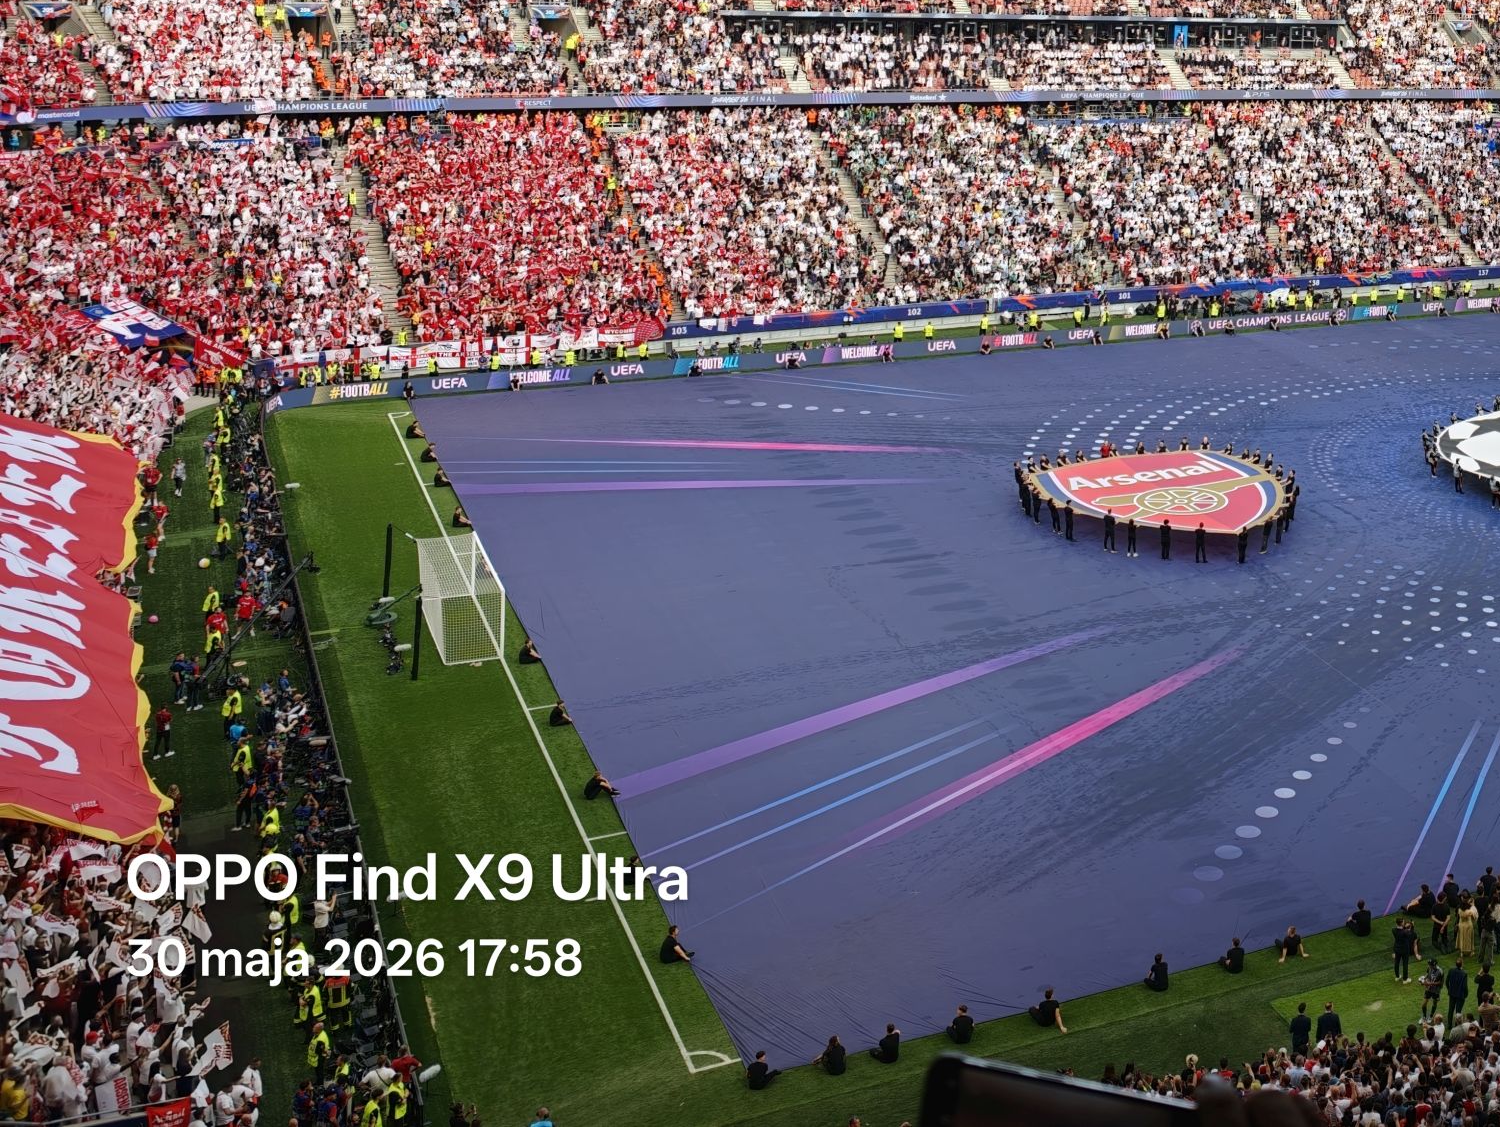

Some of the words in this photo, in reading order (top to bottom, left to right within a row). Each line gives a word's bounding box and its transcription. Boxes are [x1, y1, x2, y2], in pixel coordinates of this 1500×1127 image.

[909, 94, 937, 102] Heineken
[331, 102, 368, 110] LEAGUE
[37, 110, 80, 120] mastercard
[1422, 301, 1443, 312] UEFA
[1467, 297, 1492, 310] WELCOME
[907, 308, 921, 316] 102
[1294, 310, 1331, 324] LEAGUE
[671, 327, 687, 336] 103
[1068, 329, 1095, 340] UEFA
[1125, 324, 1157, 337] WELCOME
[993, 332, 1038, 347] #FOOTBALL
[199, 336, 213, 347] THE
[211, 341, 243, 362] ARSENAL
[927, 340, 956, 353] UEFA
[841, 346, 878, 361] WELCOME
[551, 368, 572, 382] ALL
[610, 364, 644, 377] UEFA
[431, 377, 468, 391] UEFA
[329, 382, 389, 400] #FOOTBALL
[266, 395, 284, 415] UEFA
[1068, 459, 1224, 492] Arsenal
